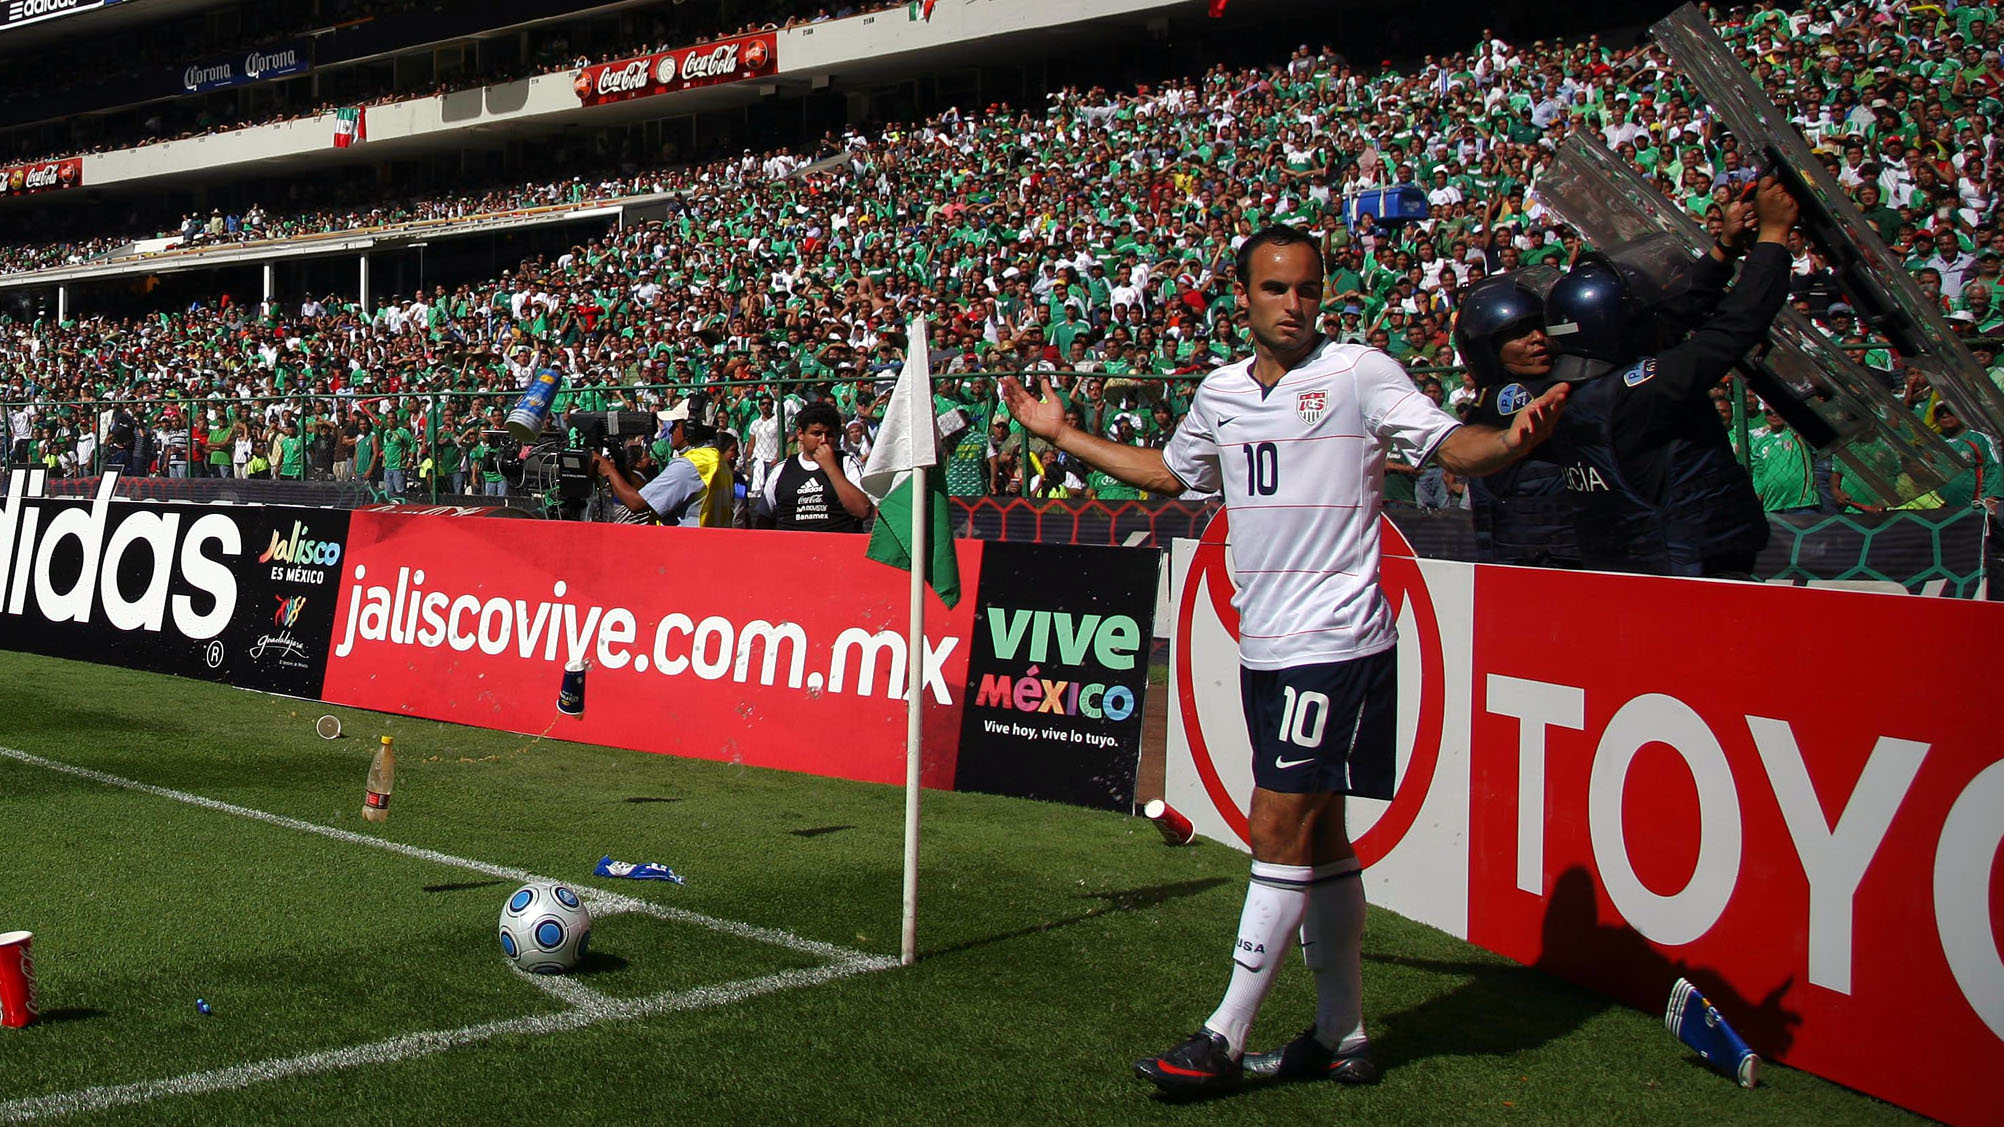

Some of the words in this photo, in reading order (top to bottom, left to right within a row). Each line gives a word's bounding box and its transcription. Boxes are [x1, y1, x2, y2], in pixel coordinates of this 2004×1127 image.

[245, 51, 296, 79] Corona
[598, 59, 651, 94] Coca-Cola
[682, 43, 739, 79] Coca-Cola
[184, 64, 230, 91] Corona
[1243, 442, 1278, 496] 10
[797, 485, 823, 494] adidas
[259, 520, 340, 566] Jalisco
[271, 567, 284, 580] ES
[286, 565, 324, 584] MÉXICO
[336, 565, 959, 705] jaliscovive.com.mx
[1279, 685, 1329, 748] 10
[984, 720, 1009, 734] Vive
[1012, 722, 1038, 740] hoy,
[1042, 727, 1067, 741] vive
[1070, 729, 1082, 742] lo
[1086, 732, 1118, 749] tuyo.
[1236, 937, 1265, 954] USA
